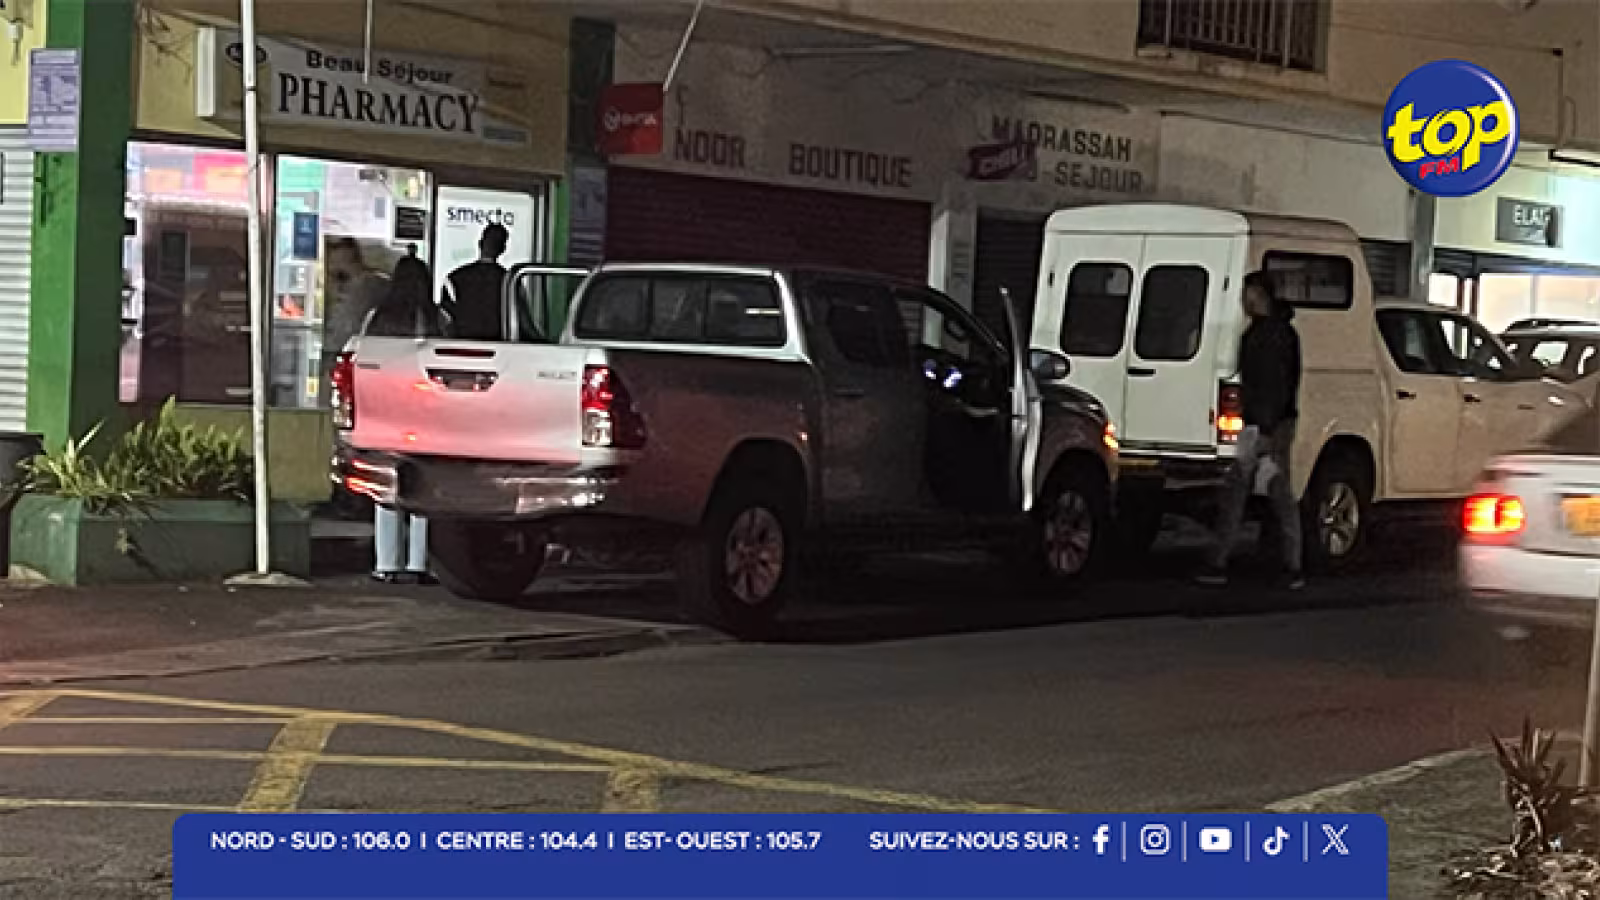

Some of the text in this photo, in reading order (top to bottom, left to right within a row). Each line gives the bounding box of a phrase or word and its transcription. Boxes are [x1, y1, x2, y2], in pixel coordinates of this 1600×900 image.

[305, 49, 364, 74] Beau
[278, 72, 479, 133] PHARMACY
[675, 128, 912, 188] NOOR BOUTIQUE
